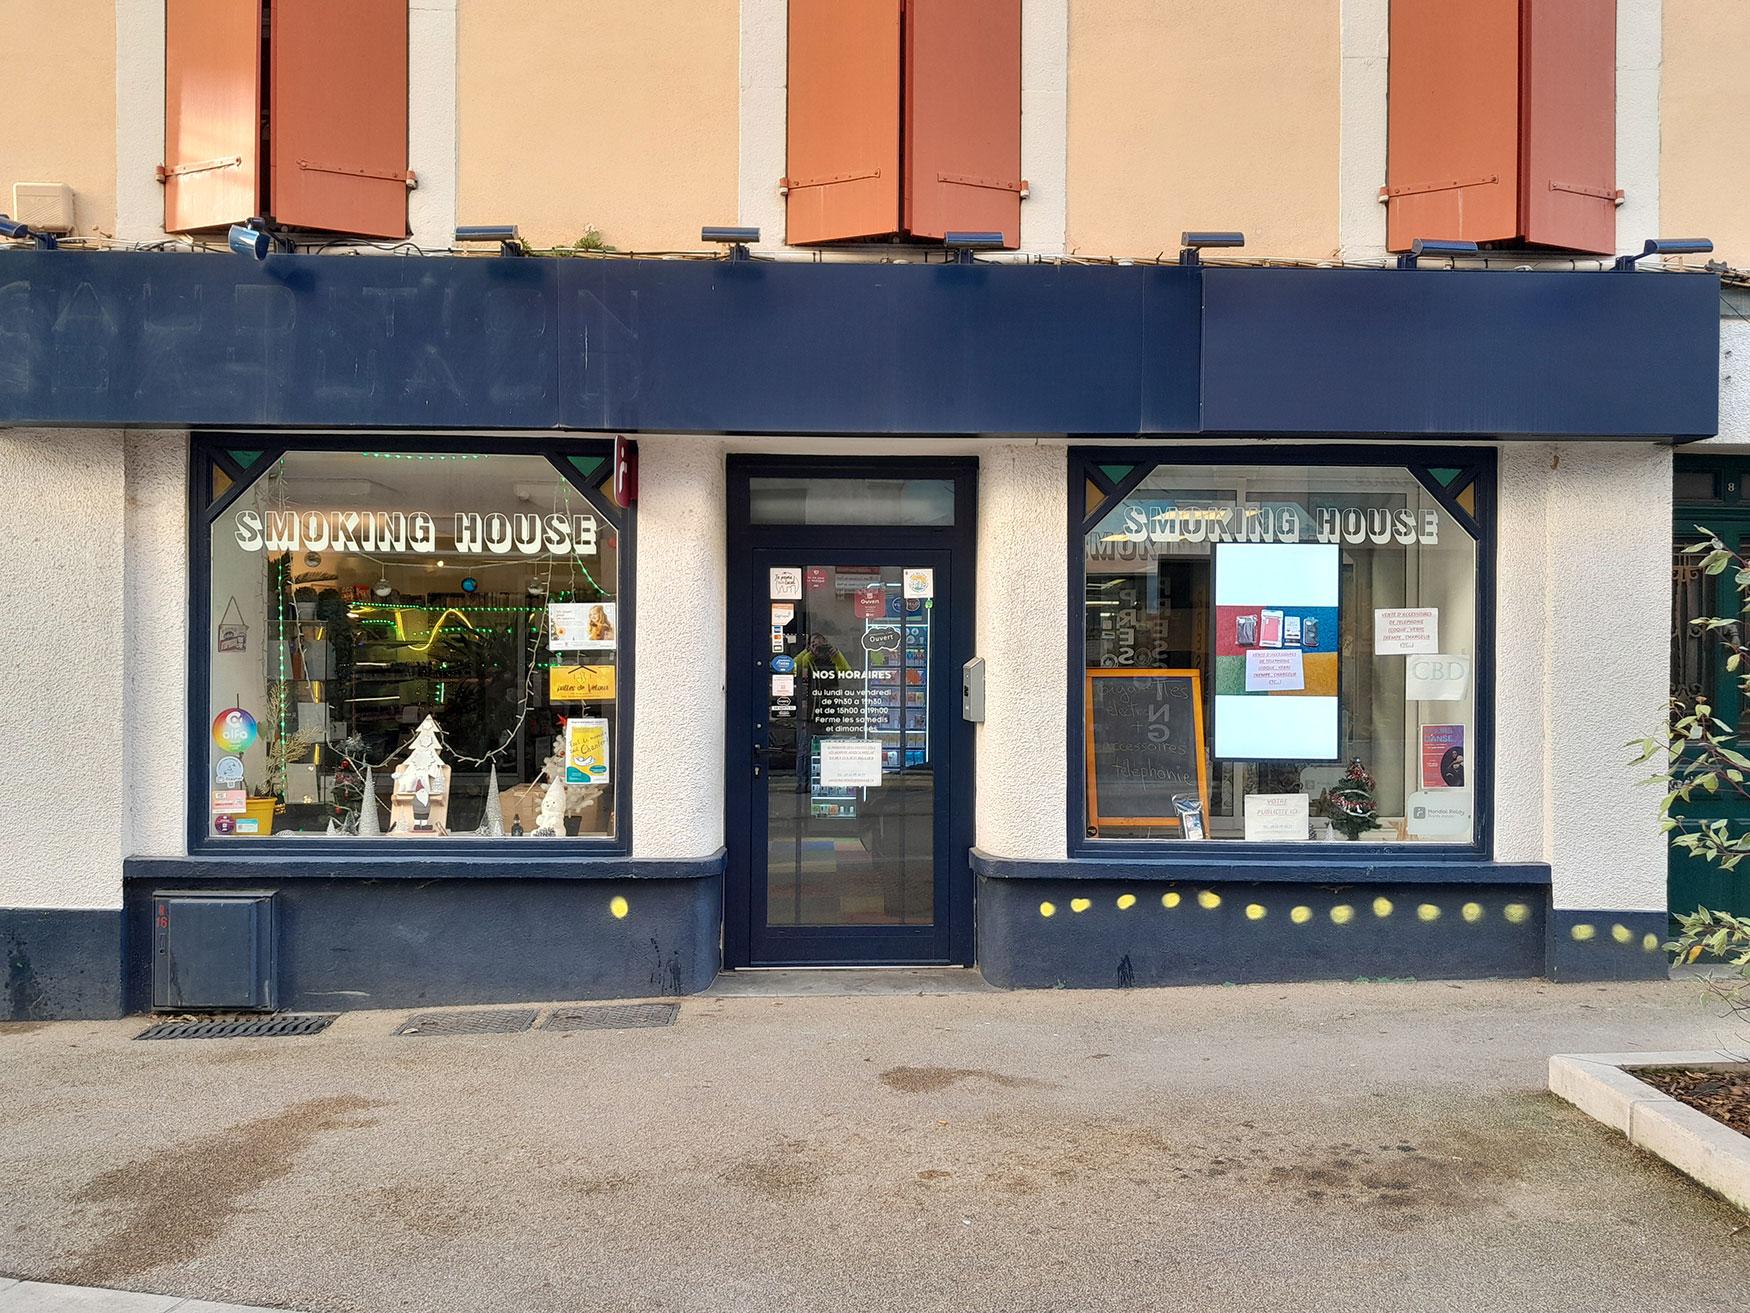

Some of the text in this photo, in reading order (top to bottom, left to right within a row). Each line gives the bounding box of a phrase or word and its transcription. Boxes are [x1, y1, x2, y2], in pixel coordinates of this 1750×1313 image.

[1727, 482, 1735, 492] 8
[234, 510, 597, 555] SMOKING HOUSE
[1123, 505, 1439, 545] SMOKING HOUSE
[869, 633, 894, 643] Ouvert
[812, 670, 892, 680] NOS HORAIRES
[1412, 661, 1465, 681] CBD
